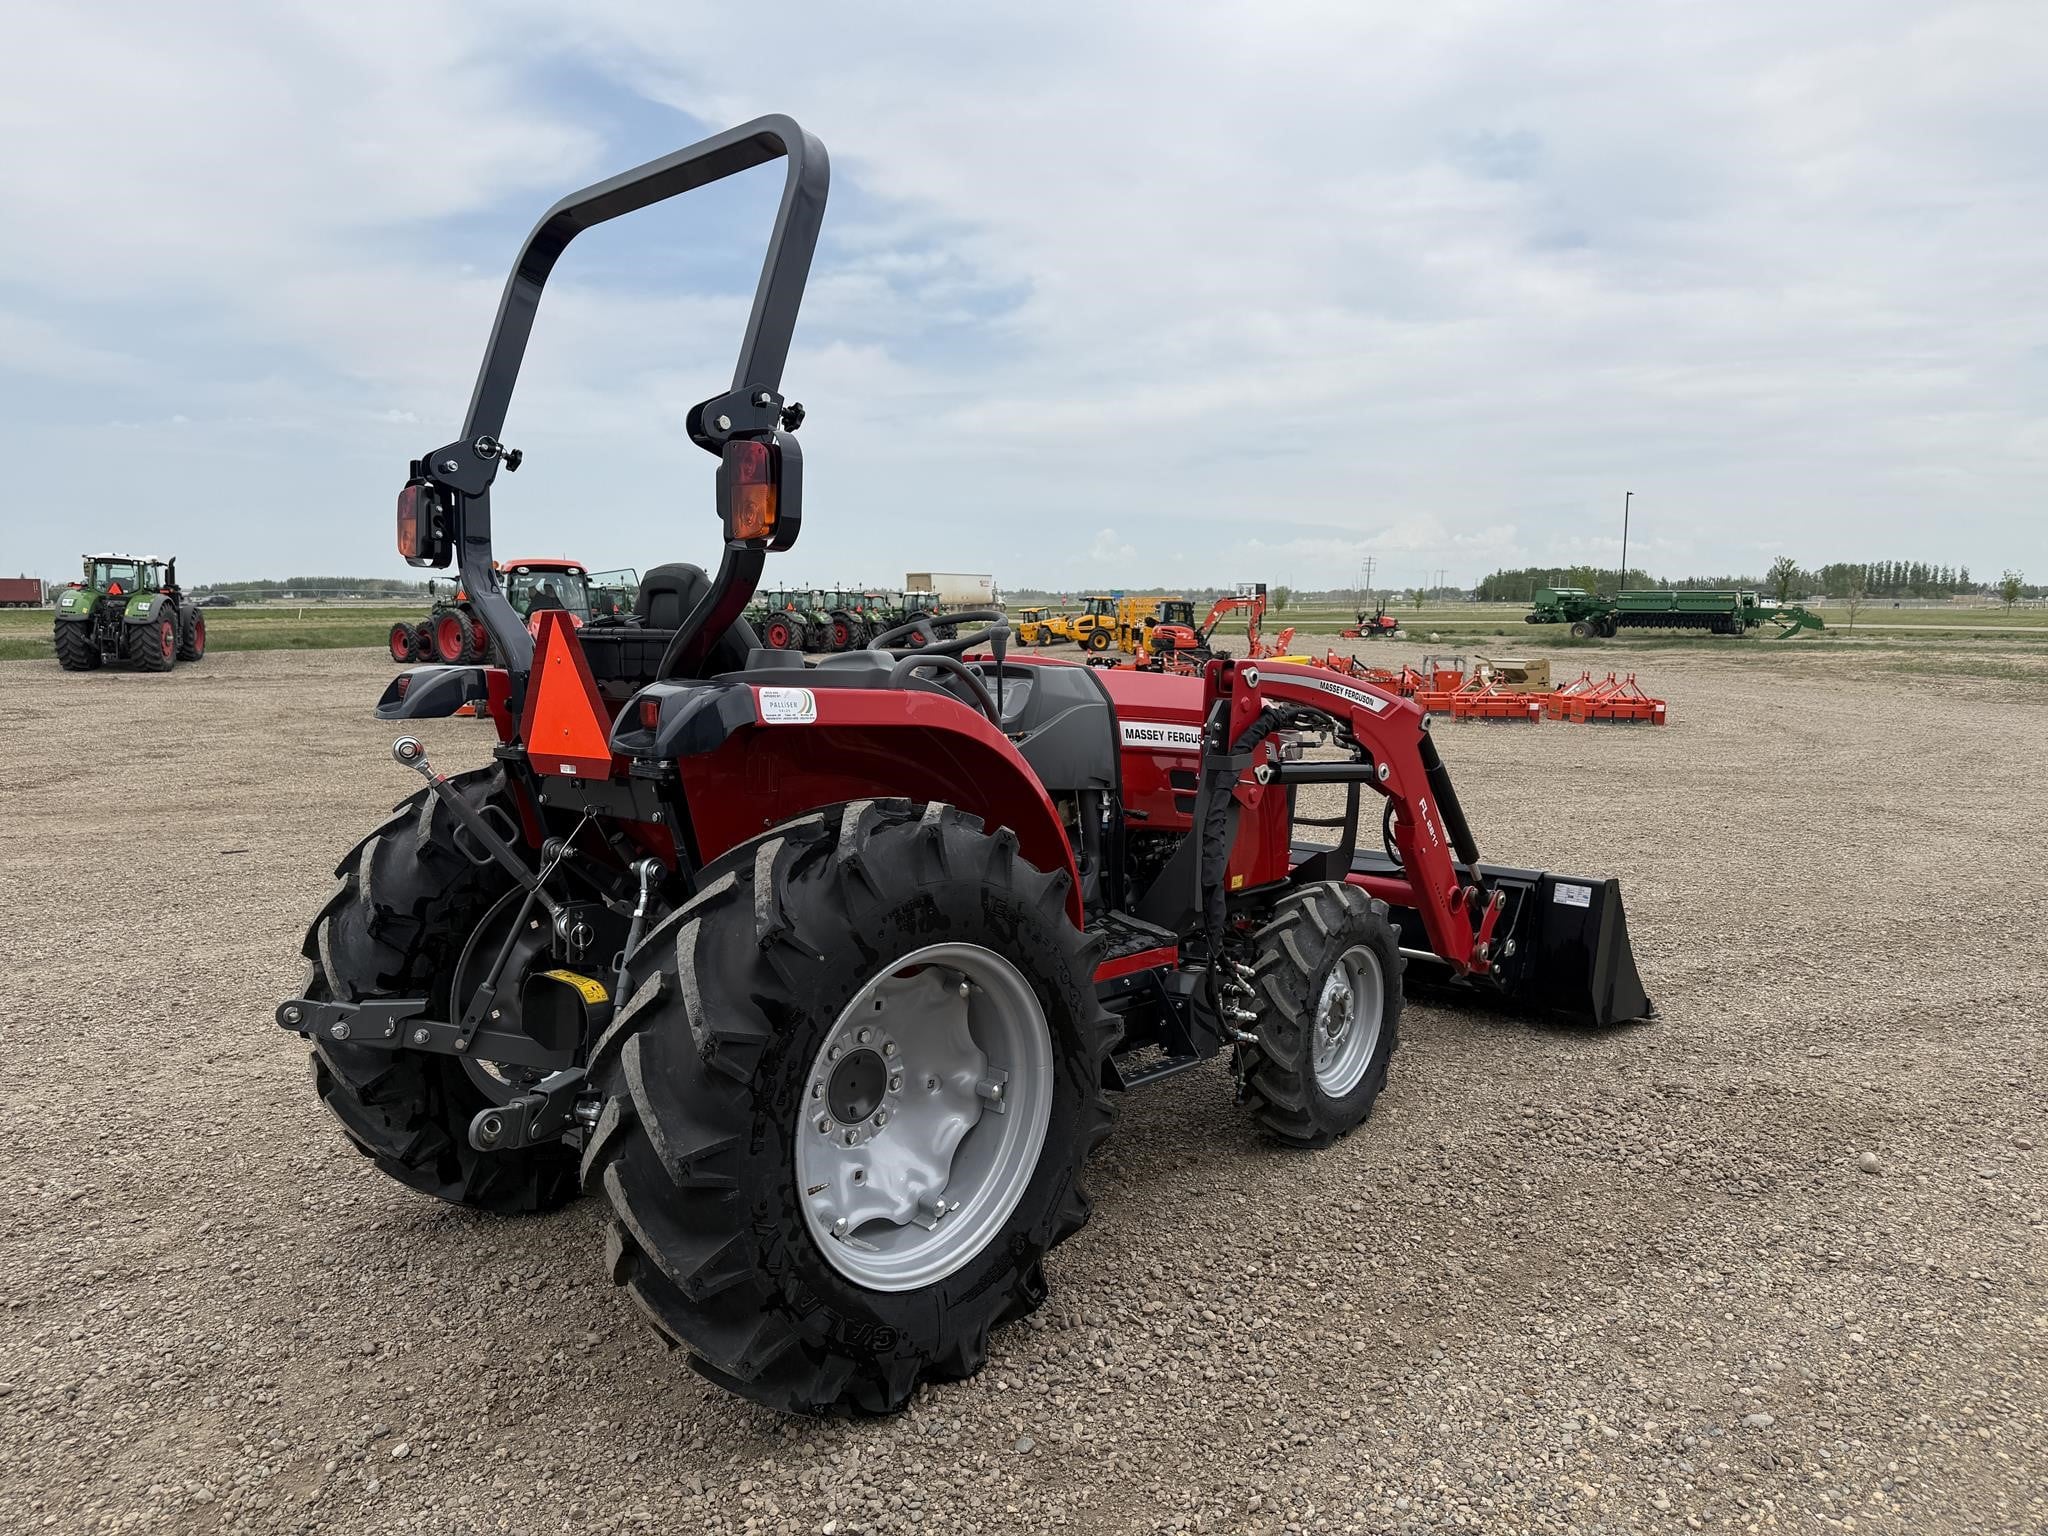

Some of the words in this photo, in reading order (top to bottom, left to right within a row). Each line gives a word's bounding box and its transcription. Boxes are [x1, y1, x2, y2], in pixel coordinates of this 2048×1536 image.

[1319, 681, 1344, 696] MASSEY
[1344, 688, 1375, 706] FERGUSON
[1125, 728, 1165, 741] MASSEY
[1418, 797, 1428, 820] FL
